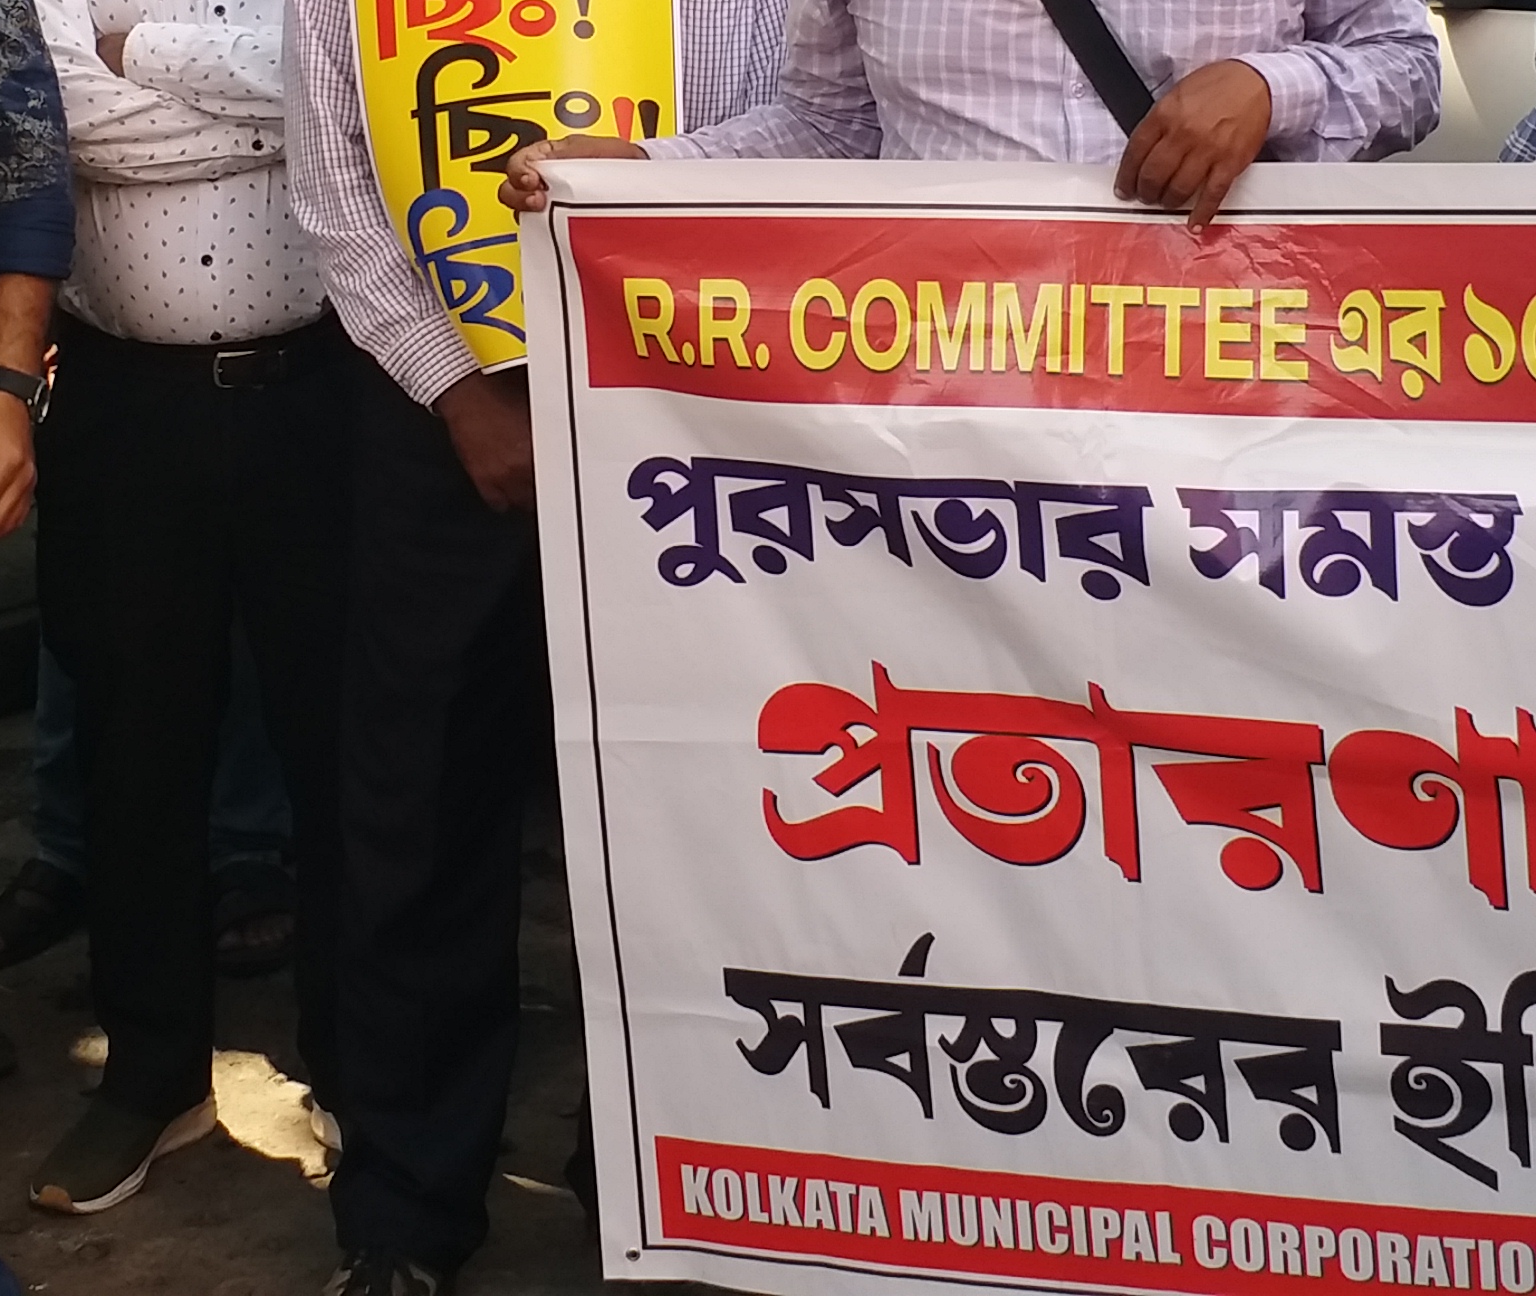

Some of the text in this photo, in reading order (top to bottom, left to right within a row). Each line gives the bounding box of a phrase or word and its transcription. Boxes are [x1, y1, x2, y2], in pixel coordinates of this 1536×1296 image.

[622, 276, 770, 371] R.R.
[788, 277, 1310, 381] COMMITTEE
[1329, 288, 1446, 399] এর
[626, 456, 1154, 601] পুরসভার
[1176, 486, 1522, 607] সমস্ত
[722, 933, 1343, 1155] সর্বস্তরের
[679, 1164, 891, 1238] KOLKATA
[898, 1188, 1181, 1265] MUNICIPAL
